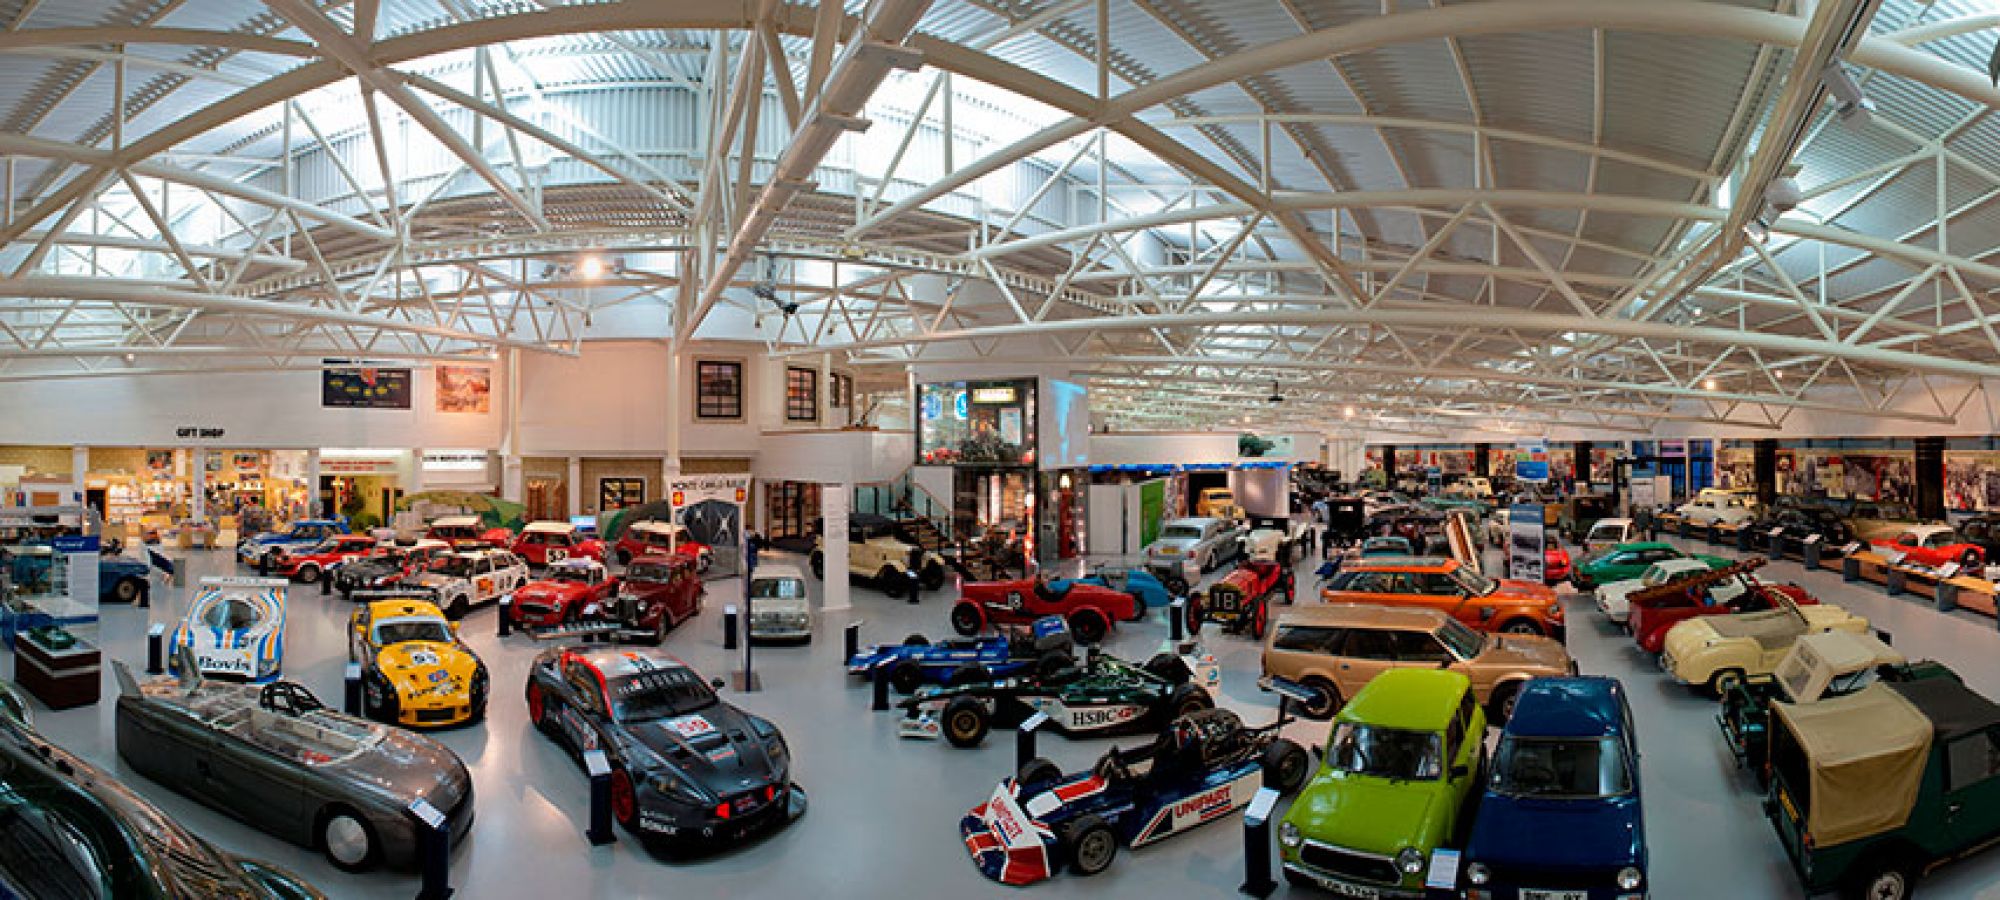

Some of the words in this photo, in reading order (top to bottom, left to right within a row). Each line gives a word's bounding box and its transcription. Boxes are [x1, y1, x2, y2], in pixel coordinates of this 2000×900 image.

[176, 427, 198, 438] GIFT
[199, 427, 225, 438] SHOP
[1213, 592, 1234, 610] 18
[198, 655, 252, 671] Bovis
[1073, 710, 1116, 726] HSBC
[1174, 784, 1232, 818] UNIPART
